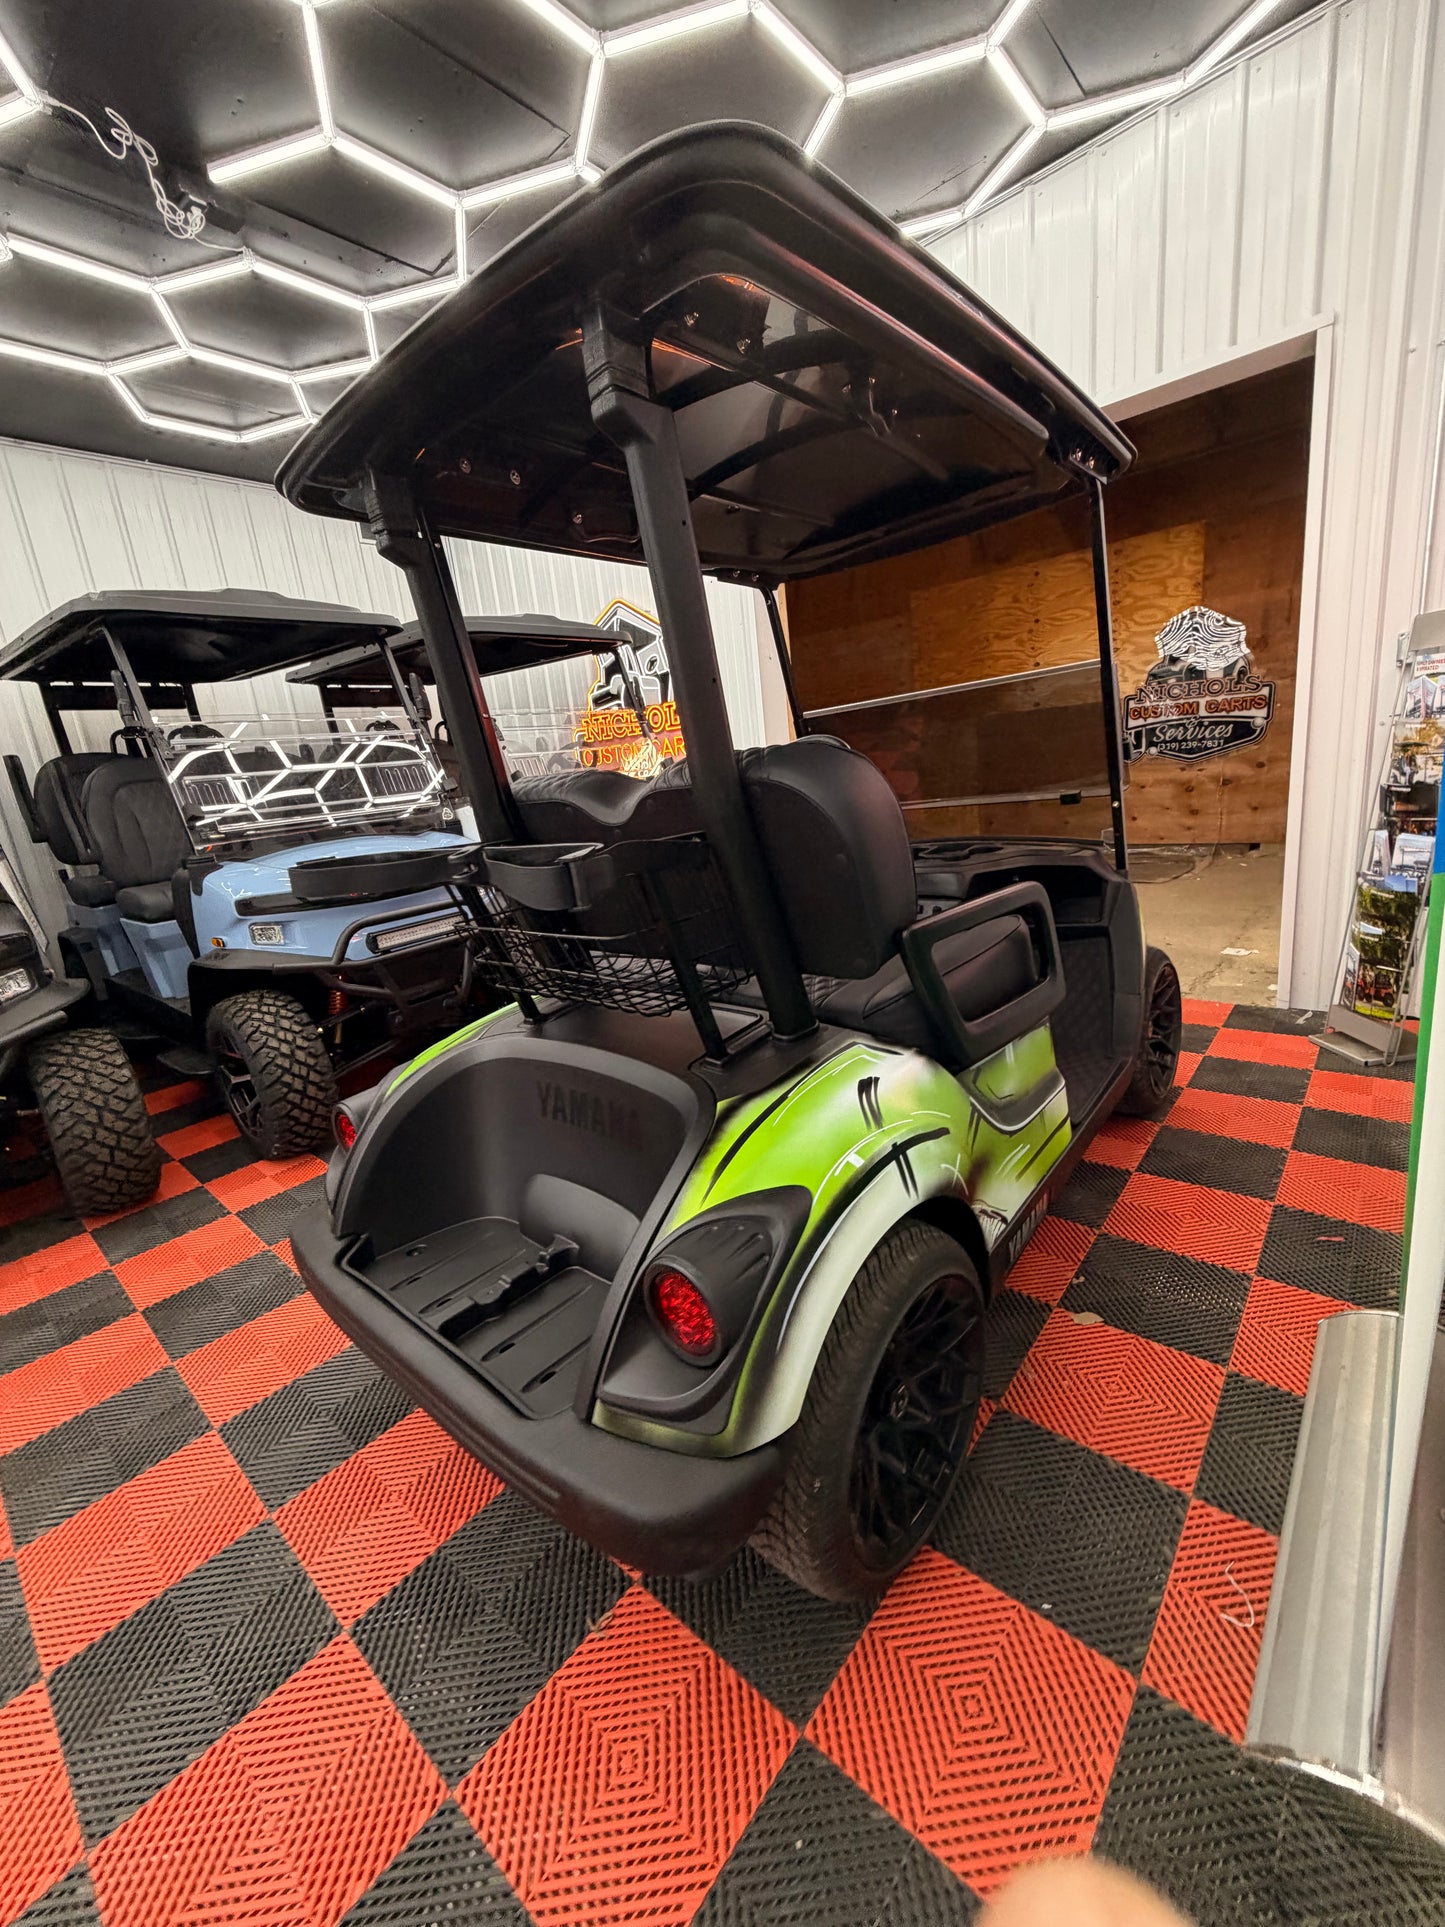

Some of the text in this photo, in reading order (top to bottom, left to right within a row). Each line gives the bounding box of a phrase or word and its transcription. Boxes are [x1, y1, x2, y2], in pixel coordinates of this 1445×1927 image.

[1136, 674, 1261, 703] NICHOLS
[1205, 694, 1267, 714] CARTS
[1153, 722, 1233, 742] Services
[1157, 740, 1224, 751] (319) 239-7831
